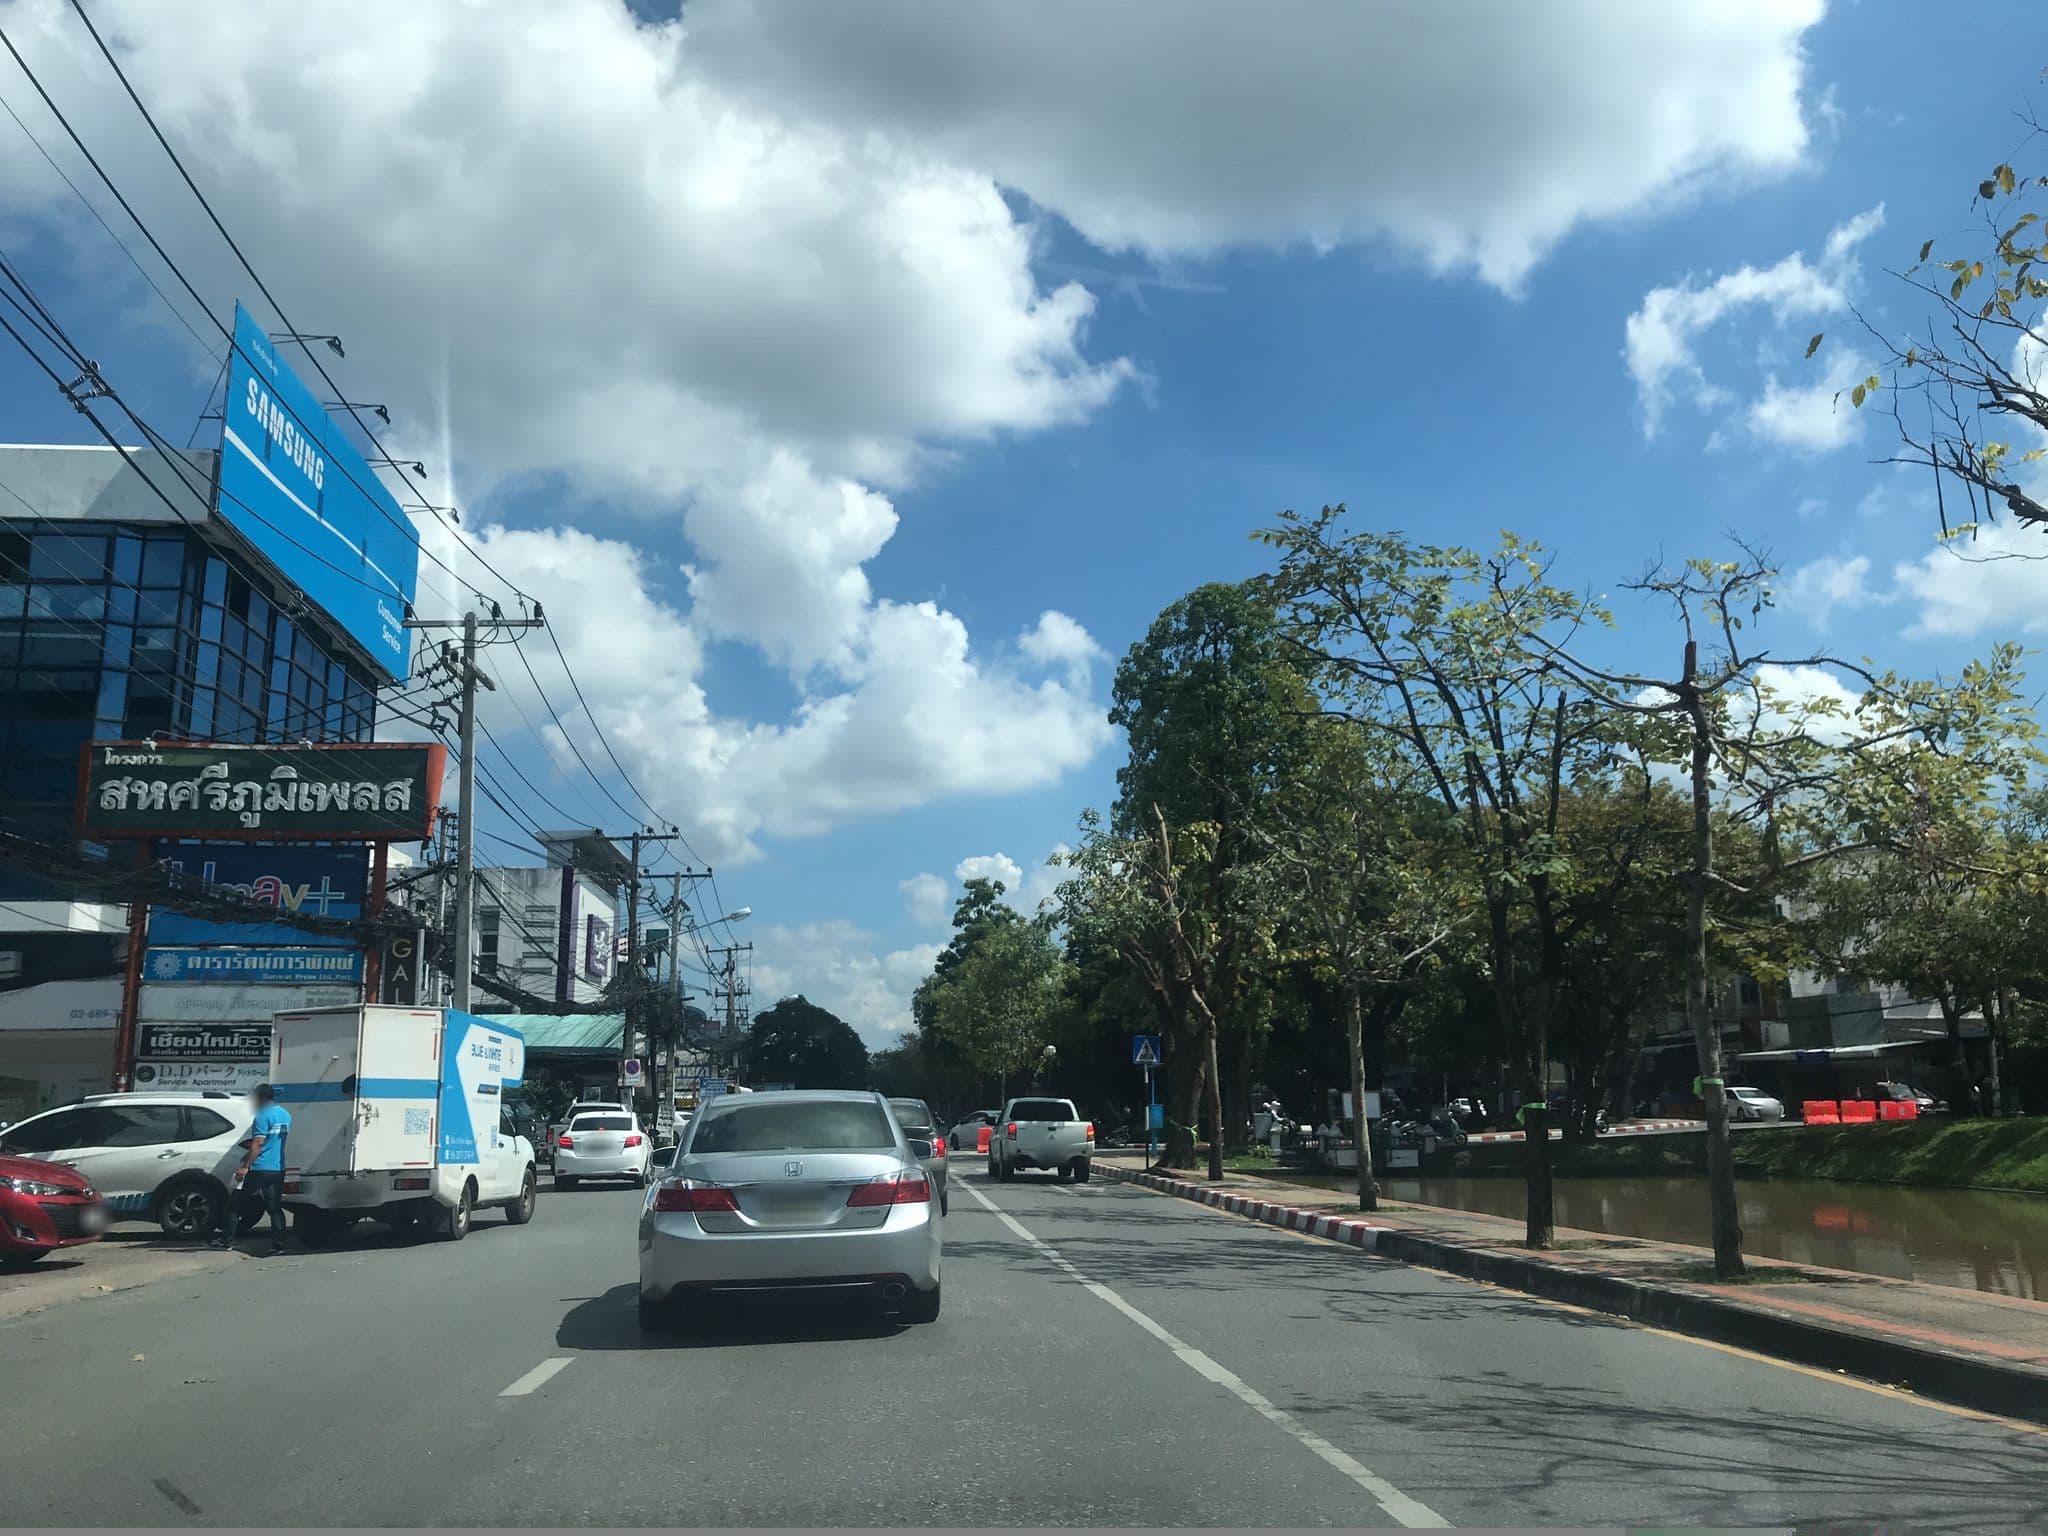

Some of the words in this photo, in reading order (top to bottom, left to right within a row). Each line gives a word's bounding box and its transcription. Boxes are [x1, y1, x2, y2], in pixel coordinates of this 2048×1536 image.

[246, 377, 325, 491] SAMSUNG
[382, 624, 402, 654] Service
[104, 747, 163, 766] โครงการ
[100, 762, 414, 828] สหศรีภูมิเพลส
[192, 1079, 236, 1088] Apartment
